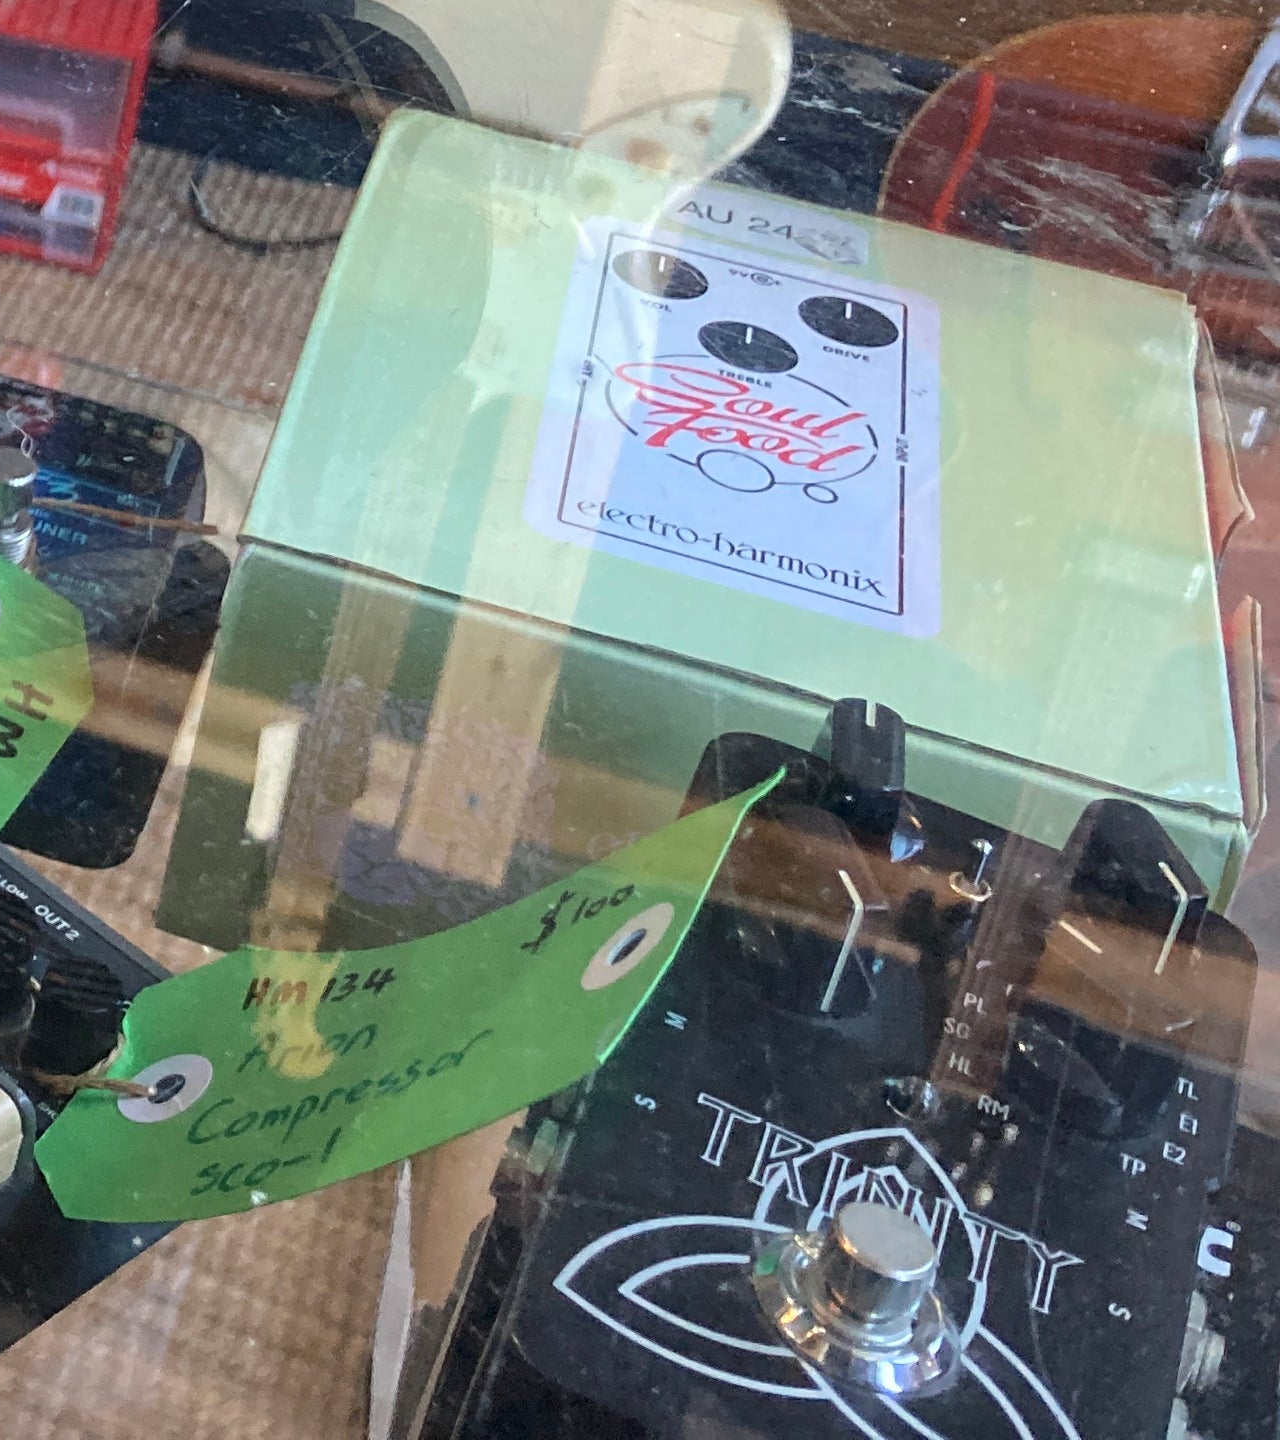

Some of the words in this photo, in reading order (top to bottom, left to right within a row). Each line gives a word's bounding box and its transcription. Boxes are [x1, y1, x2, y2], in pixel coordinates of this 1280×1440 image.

[677, 200, 734, 225] AU
[640, 298, 673, 313] VOL
[822, 345, 871, 363] DRIVE
[717, 368, 773, 390] TREBLE
[614, 362, 868, 440] Soul
[643, 410, 867, 472] Food
[576, 499, 888, 598] electro-harmonix
[185, 1028, 495, 1147] Compressor
[977, 1094, 1011, 1120] RM
[1120, 1152, 1147, 1176] TP
